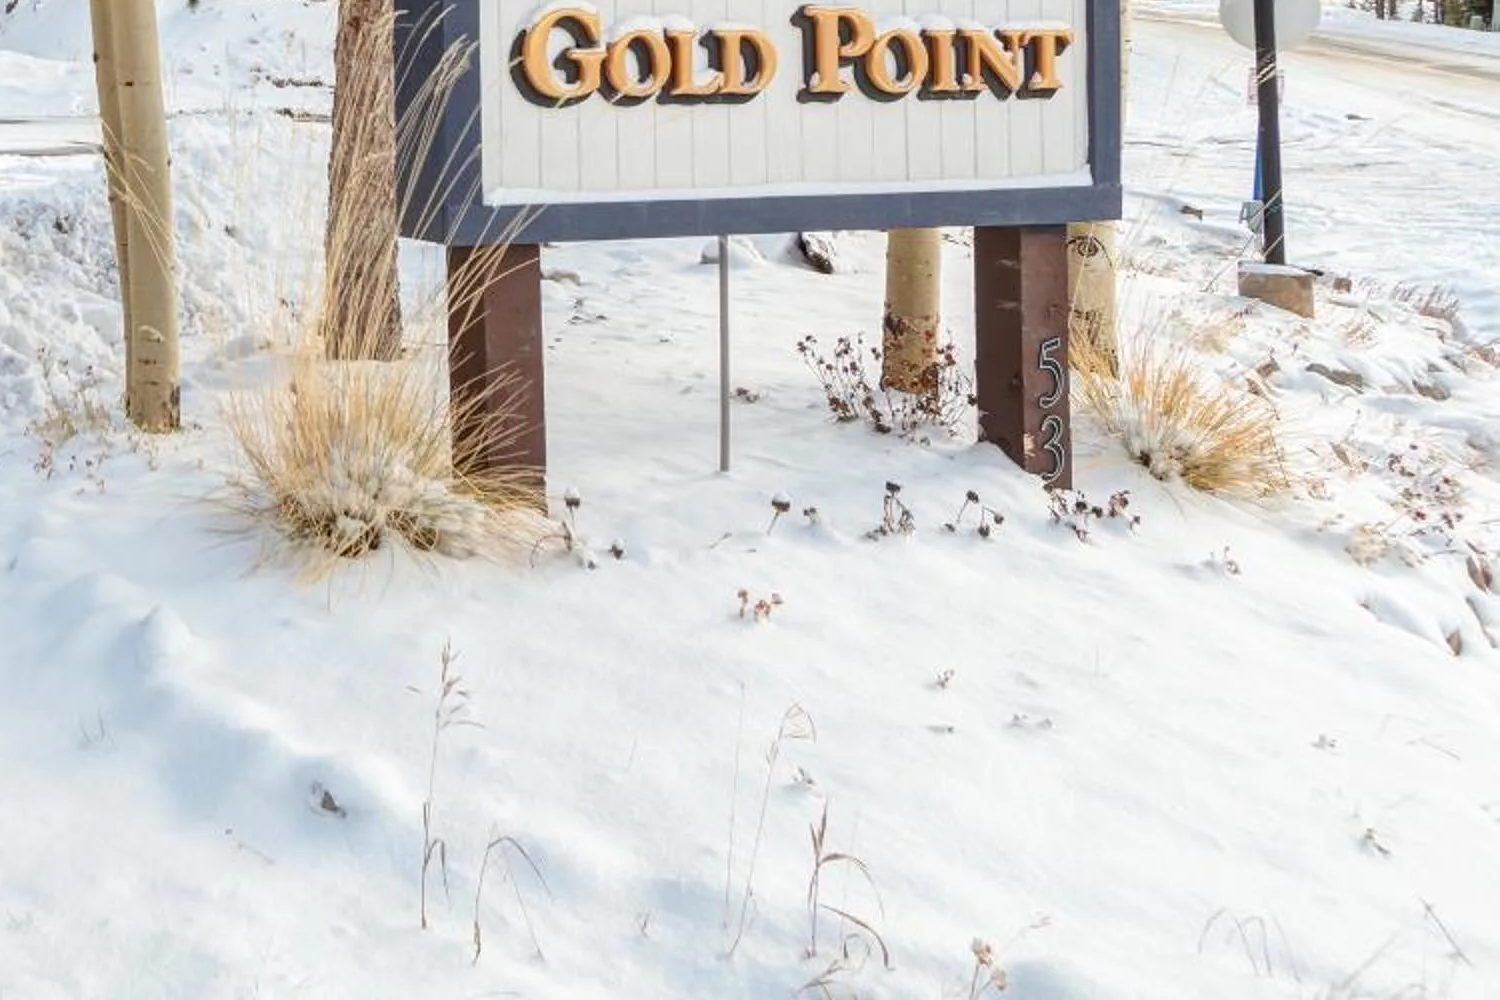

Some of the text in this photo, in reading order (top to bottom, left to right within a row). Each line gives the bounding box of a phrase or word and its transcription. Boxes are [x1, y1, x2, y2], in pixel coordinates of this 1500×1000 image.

[512, 3, 1074, 108] GOLD POINT
[1038, 336, 1066, 483] 53
